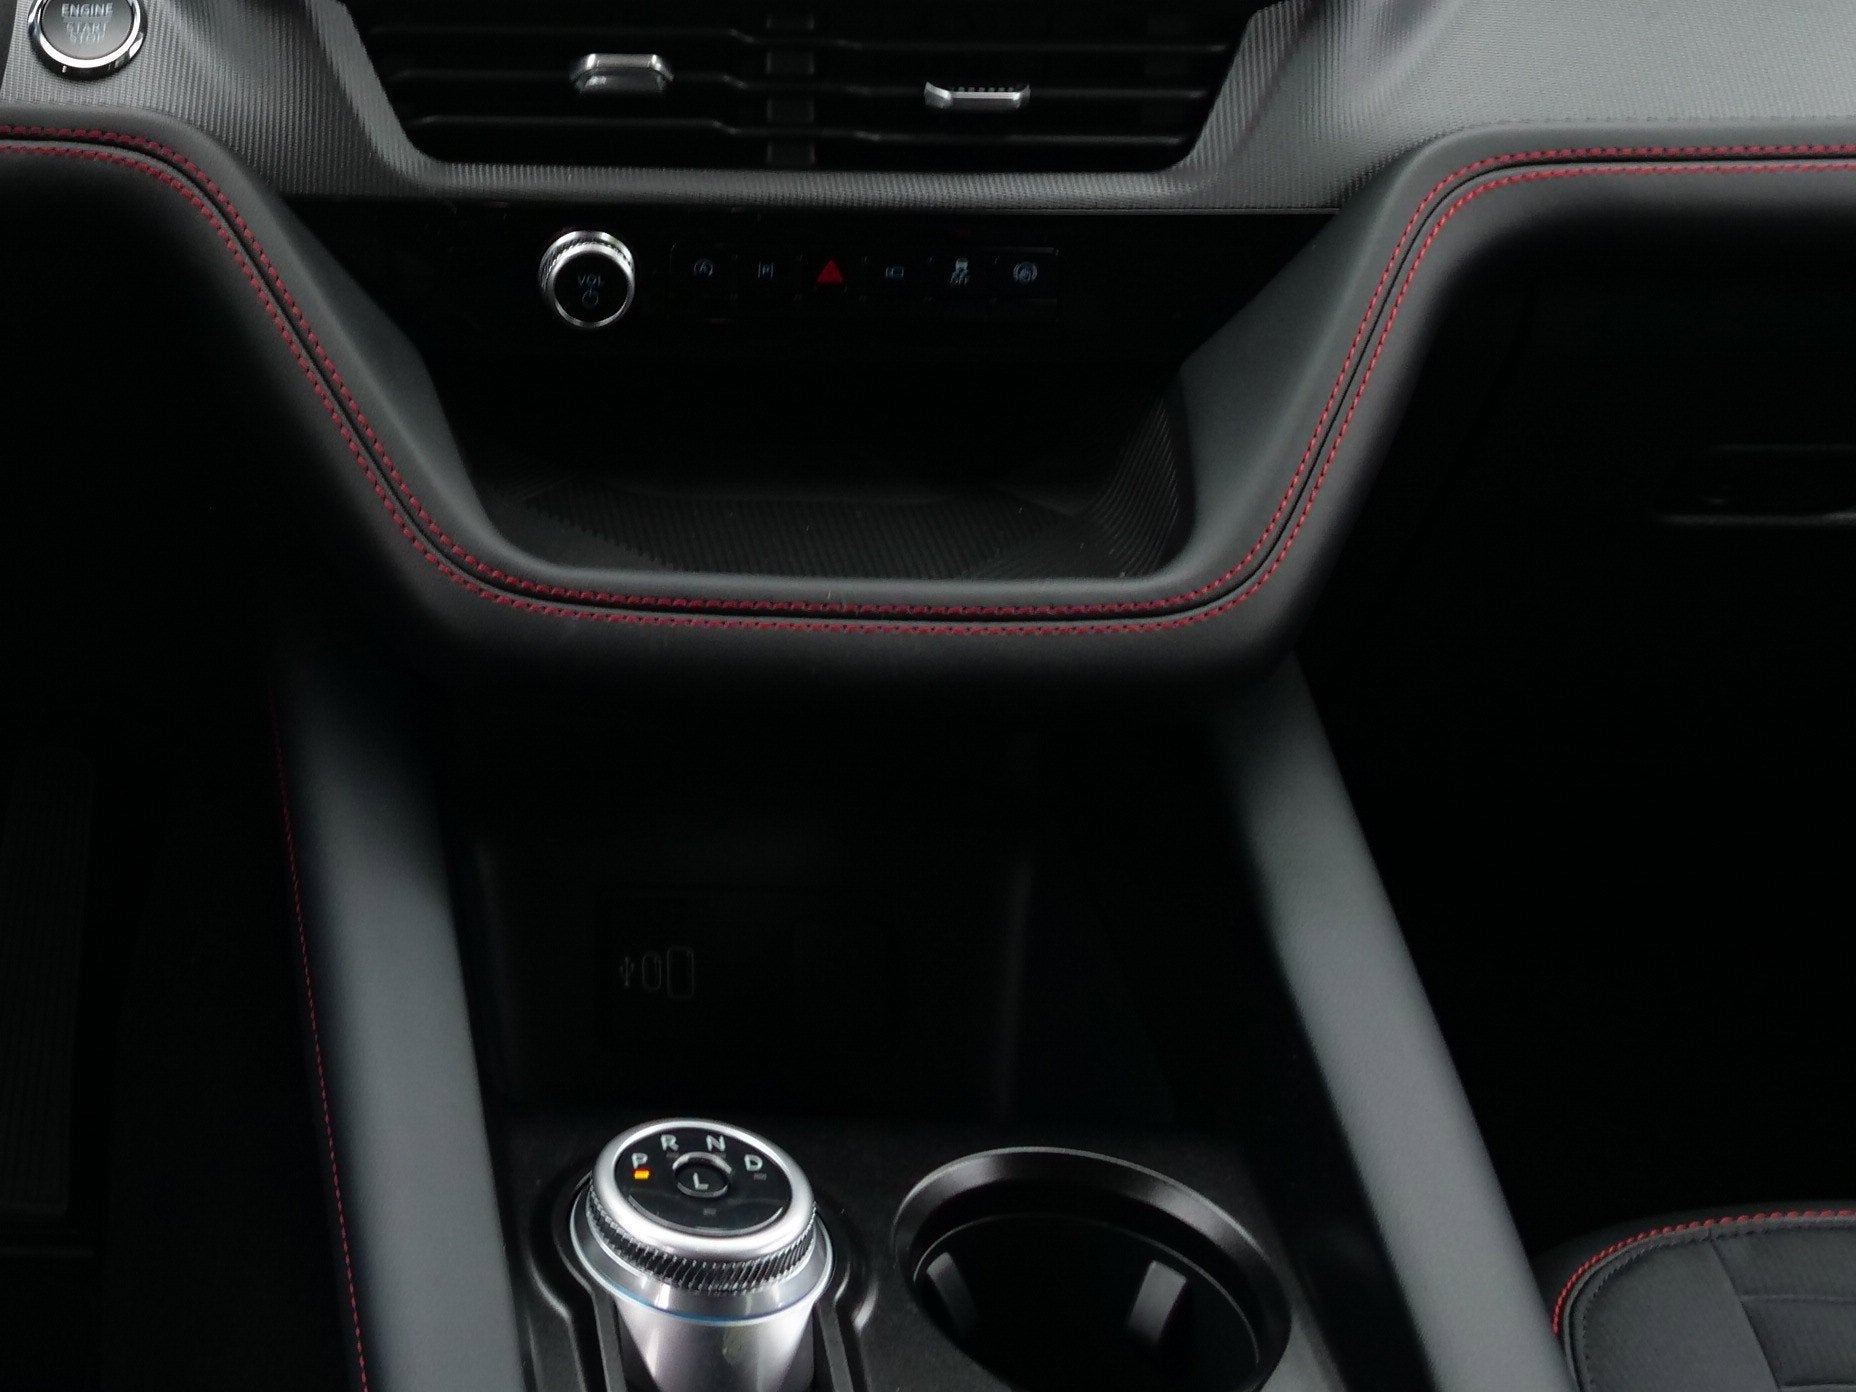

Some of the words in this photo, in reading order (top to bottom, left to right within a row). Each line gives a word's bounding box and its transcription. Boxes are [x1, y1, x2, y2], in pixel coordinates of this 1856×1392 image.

[61, 3, 114, 17] ENGINE
[66, 21, 107, 34] START
[578, 274, 602, 287] VOL
[632, 1153, 648, 1169] P
[660, 1134, 680, 1151] R
[705, 1134, 726, 1152] N
[745, 1154, 763, 1171] D
[693, 1172, 709, 1190] L
